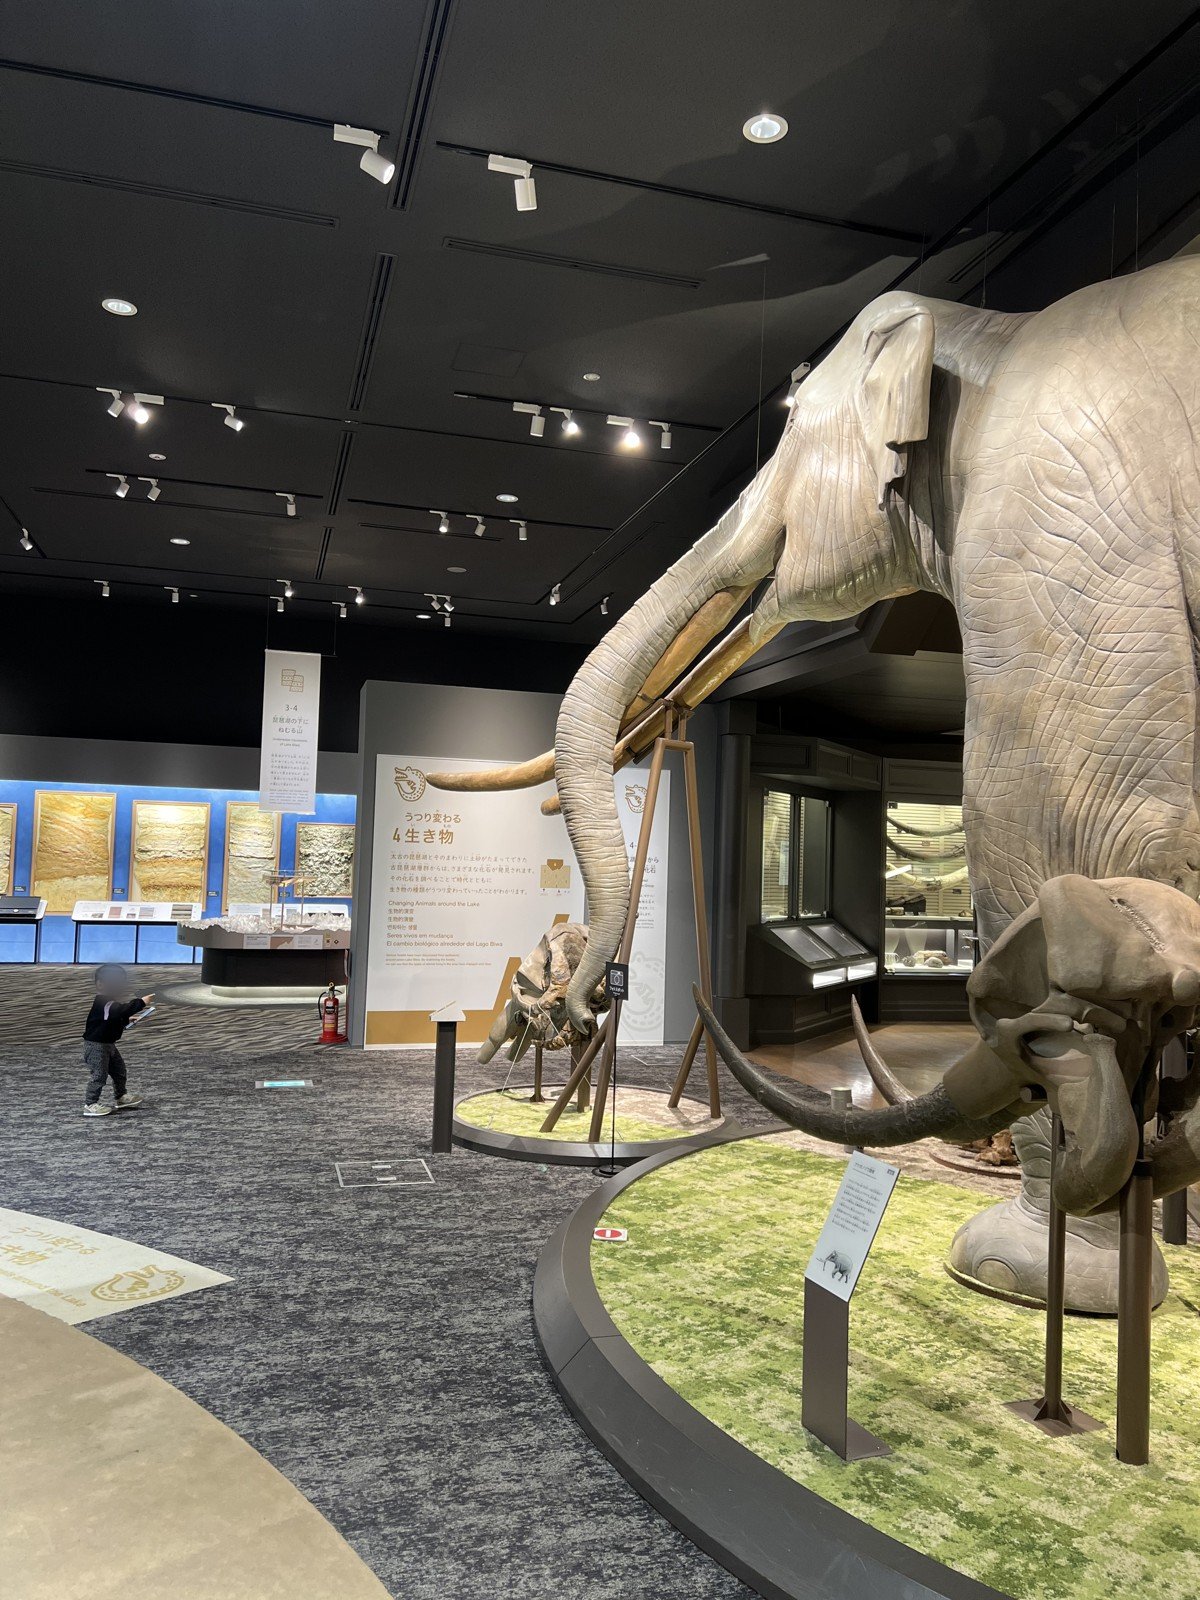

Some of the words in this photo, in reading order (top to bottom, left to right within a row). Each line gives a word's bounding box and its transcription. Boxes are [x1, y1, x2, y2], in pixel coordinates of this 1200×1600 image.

[405, 812, 461, 824] うつり変わる
[393, 827, 401, 843] 4
[405, 828, 454, 844] 生き物
[8, 1226, 101, 1254] うつり変わる
[60, 1294, 87, 1307] Lake
